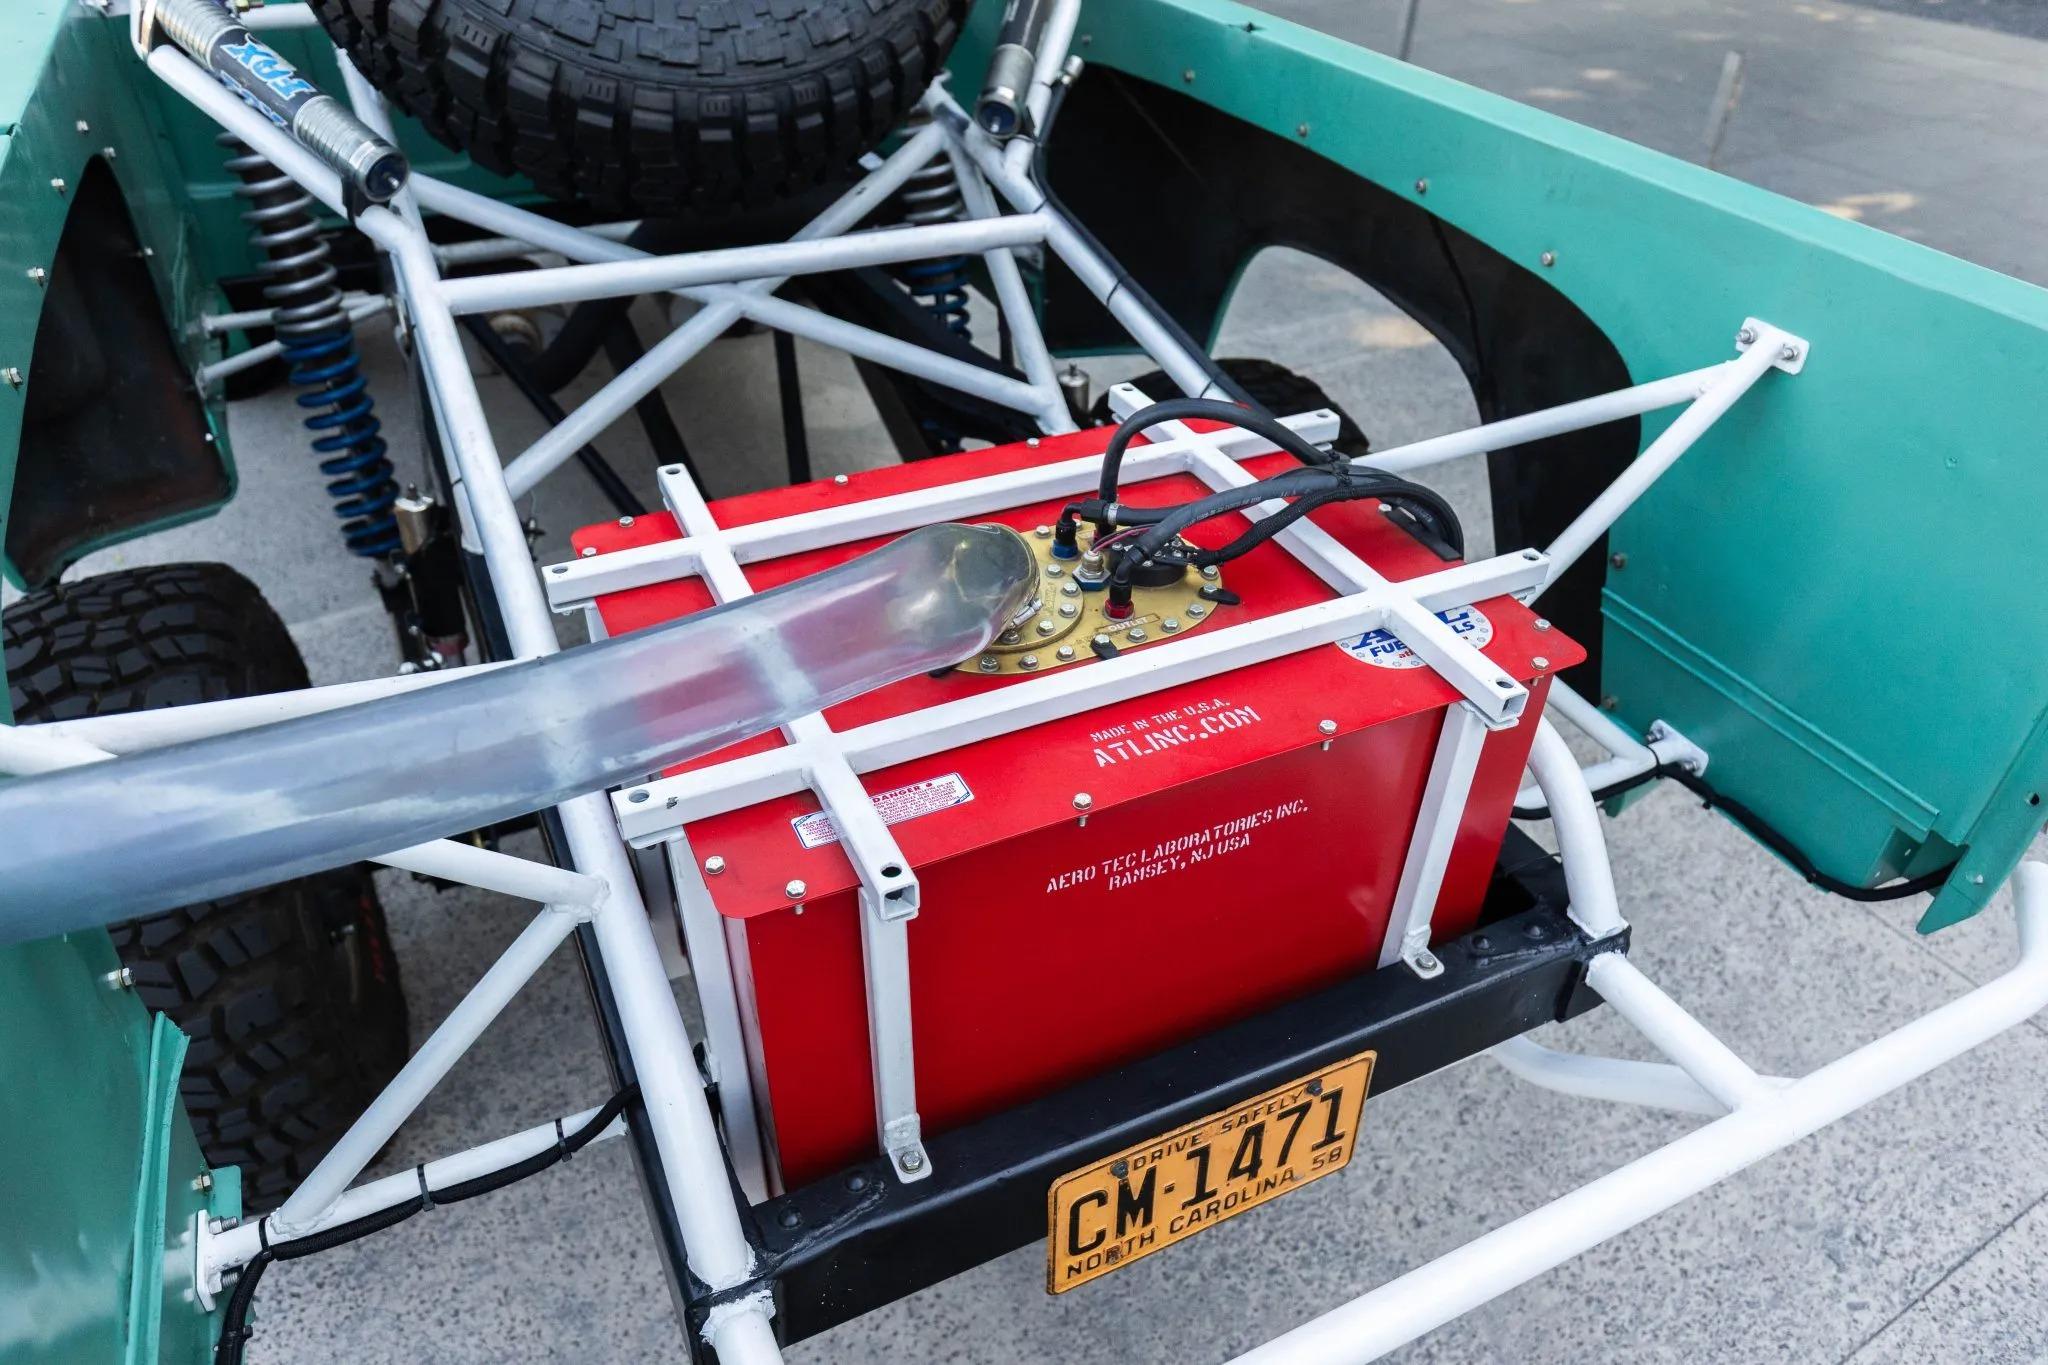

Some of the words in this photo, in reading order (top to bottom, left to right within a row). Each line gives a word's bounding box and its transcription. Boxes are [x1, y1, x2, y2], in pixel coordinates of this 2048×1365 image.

[1108, 616, 1149, 631] OUTLET
[1090, 725, 1131, 743] MADE
[1132, 719, 1150, 731] IN
[1151, 710, 1183, 725] THE
[1183, 698, 1231, 716] U.S.A.
[1093, 705, 1262, 768] ATLINC.COM
[872, 785, 920, 804] DANGER
[1046, 865, 1096, 893] AERO
[1101, 852, 1137, 875] TEC
[1141, 809, 1272, 864] LABORATORIES
[1276, 798, 1309, 820] INC.
[1109, 856, 1186, 890] RAMSEY,
[1190, 845, 1214, 865] NJ
[1217, 832, 1250, 851] USA
[1133, 1133, 1201, 1171] DRIVE
[1220, 1089, 1304, 1135] SAFELY
[1067, 1230, 1156, 1280] NORTH
[1169, 1167, 1295, 1235] CAROLINA
[1312, 1149, 1342, 1170] 58
